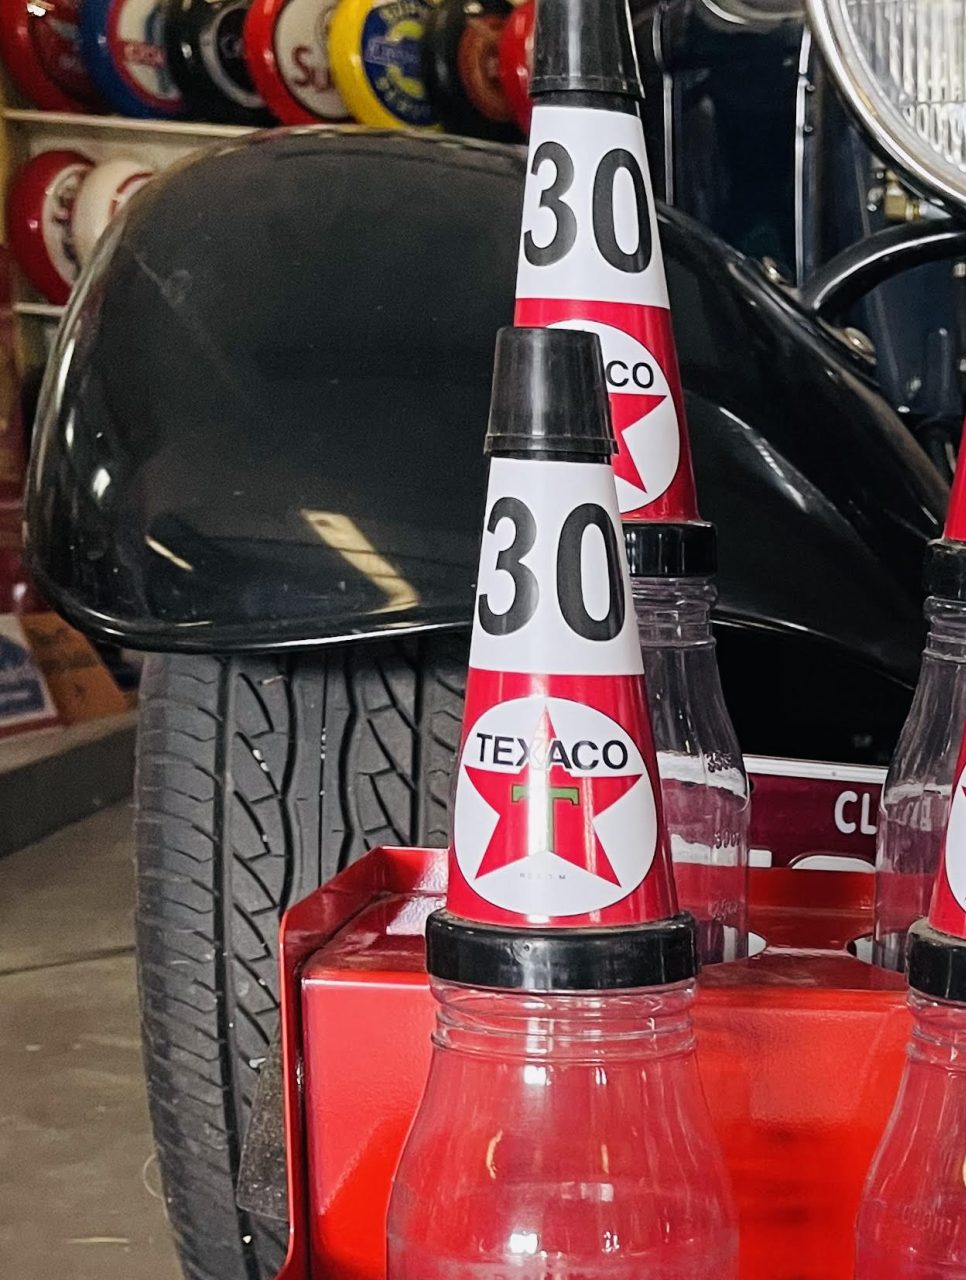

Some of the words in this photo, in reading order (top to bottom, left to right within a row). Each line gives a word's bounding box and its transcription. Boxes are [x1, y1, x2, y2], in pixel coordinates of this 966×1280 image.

[523, 141, 653, 273] 30
[478, 496, 626, 641] 30
[476, 732, 629, 771] TEXACO
